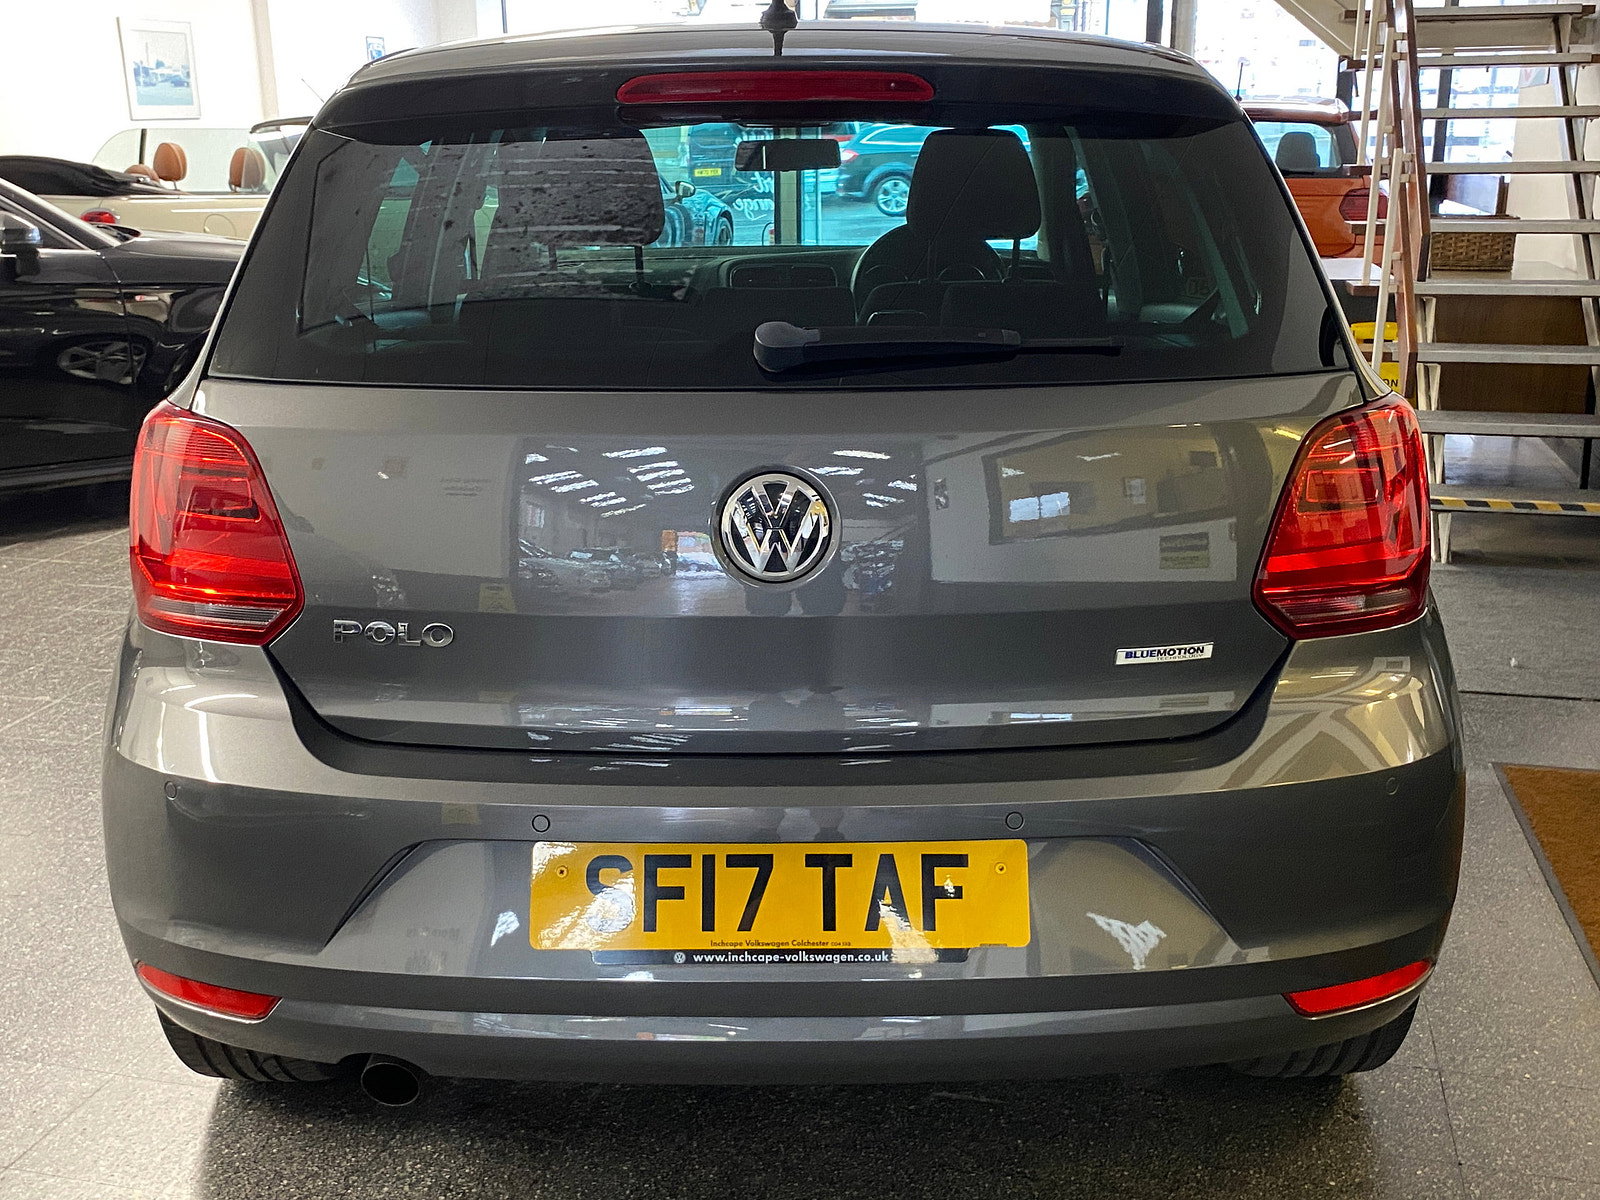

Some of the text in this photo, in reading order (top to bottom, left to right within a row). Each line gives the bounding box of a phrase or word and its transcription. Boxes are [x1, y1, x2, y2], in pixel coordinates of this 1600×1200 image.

[333, 619, 454, 647] POLO
[1125, 646, 1205, 659] BLUEMOTION
[585, 853, 969, 933] SF17 TAF
[745, 939, 789, 947] Volkswagen
[791, 939, 829, 947] Colchester
[693, 951, 889, 964] www.inchcape-volkswagen.co.uk
